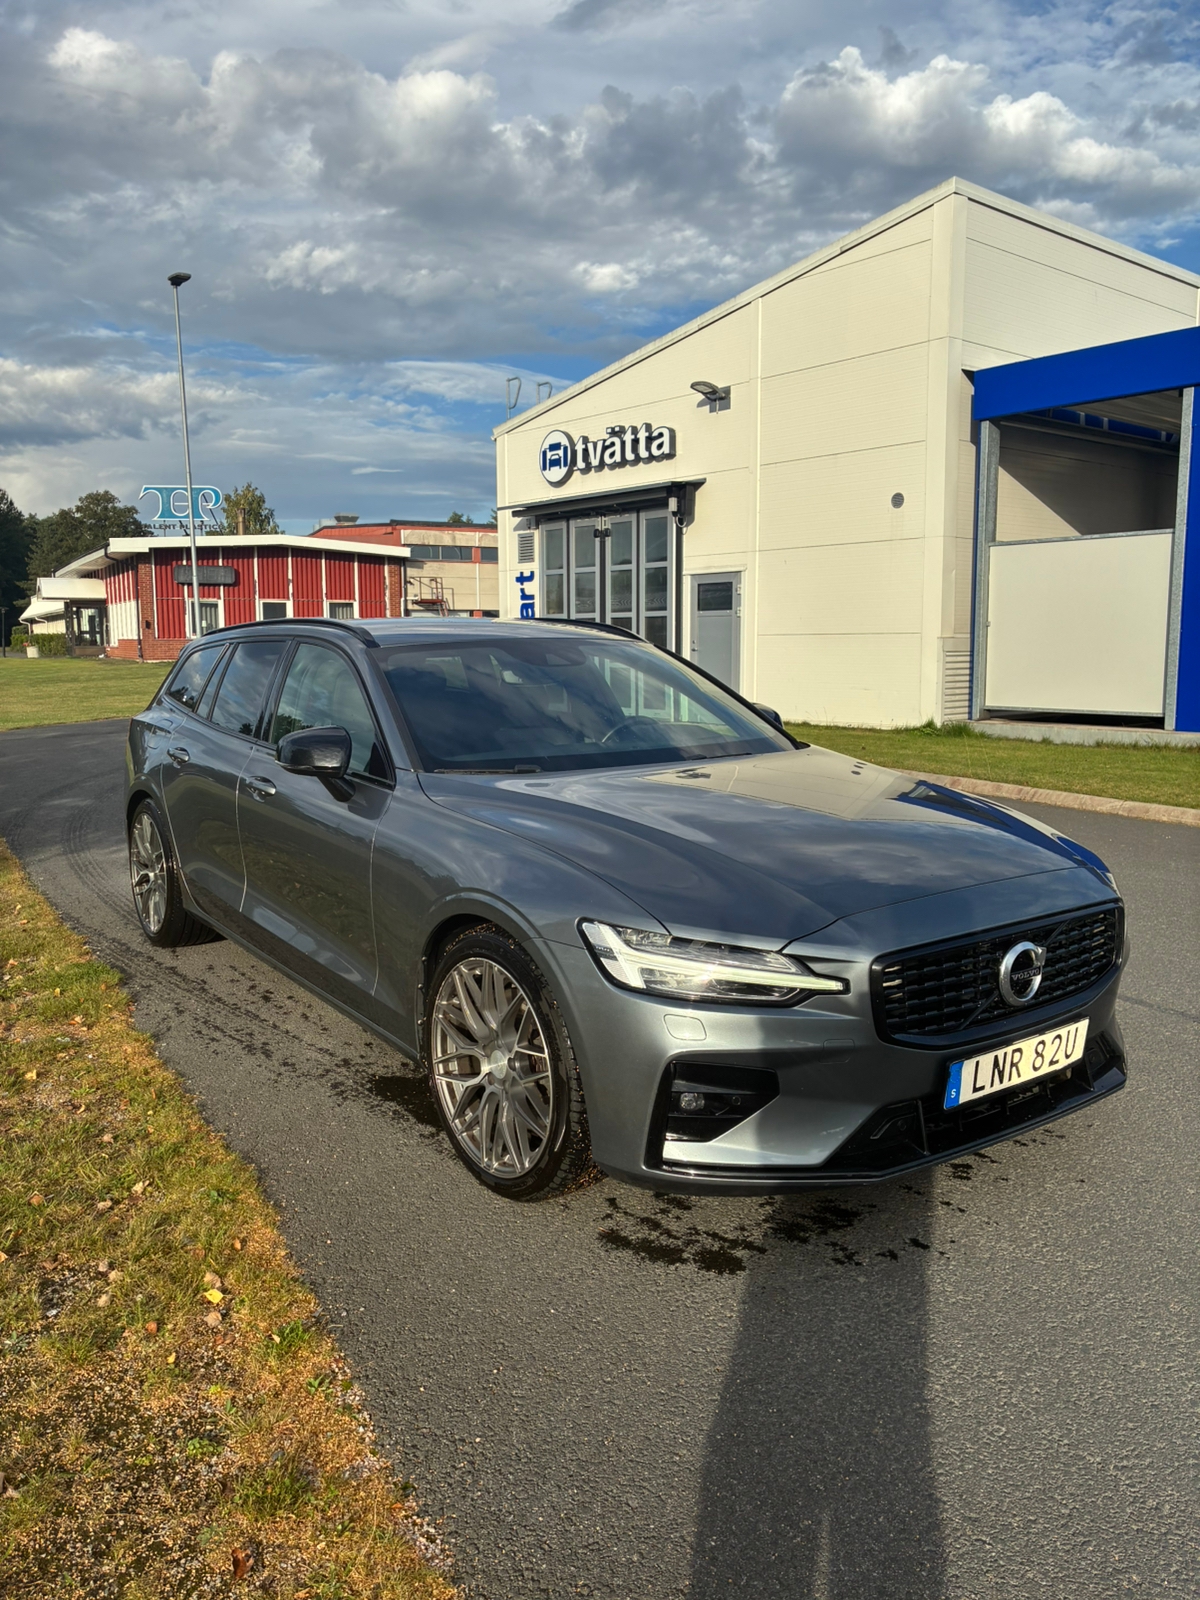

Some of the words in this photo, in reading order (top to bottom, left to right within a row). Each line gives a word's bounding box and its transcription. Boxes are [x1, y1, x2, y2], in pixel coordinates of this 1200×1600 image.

[575, 422, 671, 470] tvätta
[1011, 968, 1039, 981] VOLVO
[972, 1047, 1023, 1094] LNR
[1032, 1026, 1079, 1072] 82U
[950, 1088, 957, 1098] S
